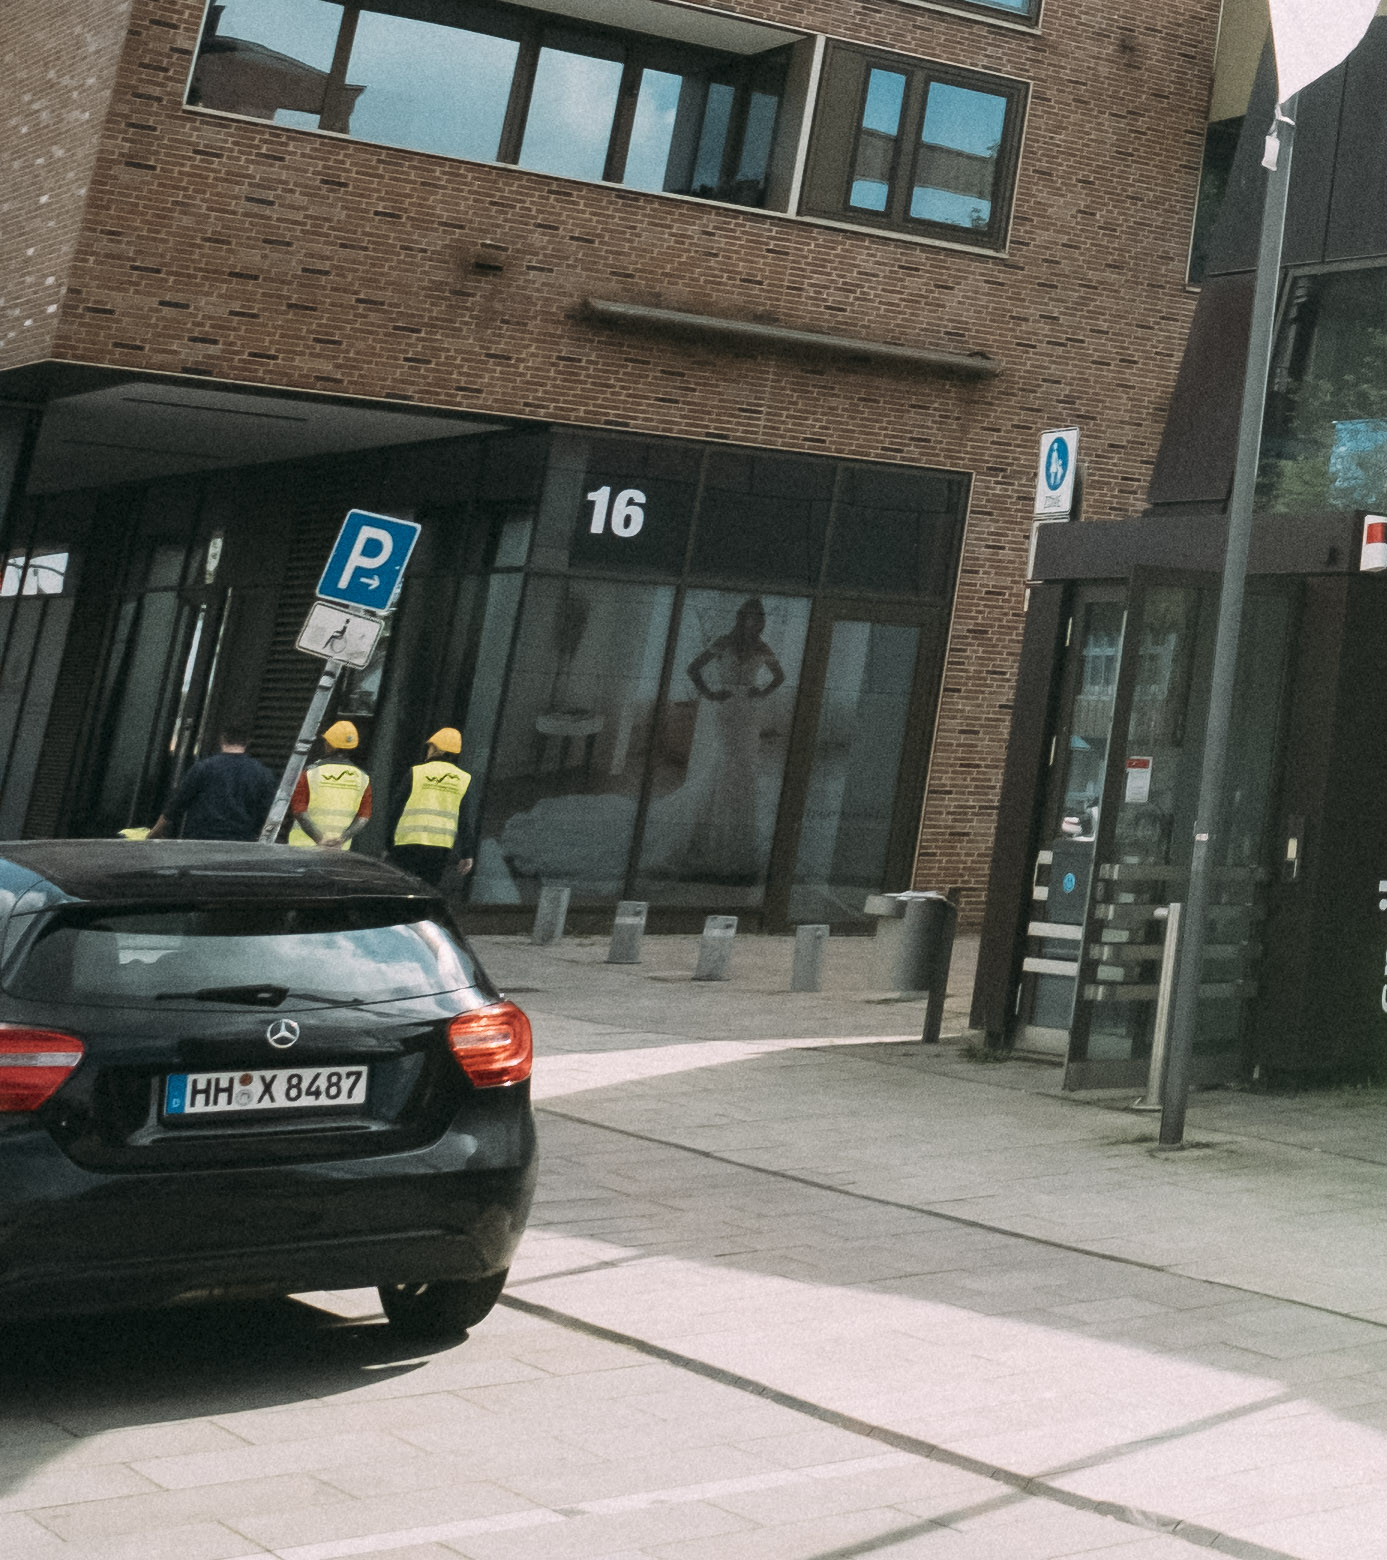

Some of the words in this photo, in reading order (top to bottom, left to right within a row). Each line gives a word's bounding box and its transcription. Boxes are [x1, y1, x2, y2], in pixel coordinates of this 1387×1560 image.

[587, 486, 647, 537] 16
[337, 525, 394, 590] P
[190, 1077, 234, 1107] HH
[257, 1074, 278, 1104] X
[285, 1071, 363, 1102] 8487
